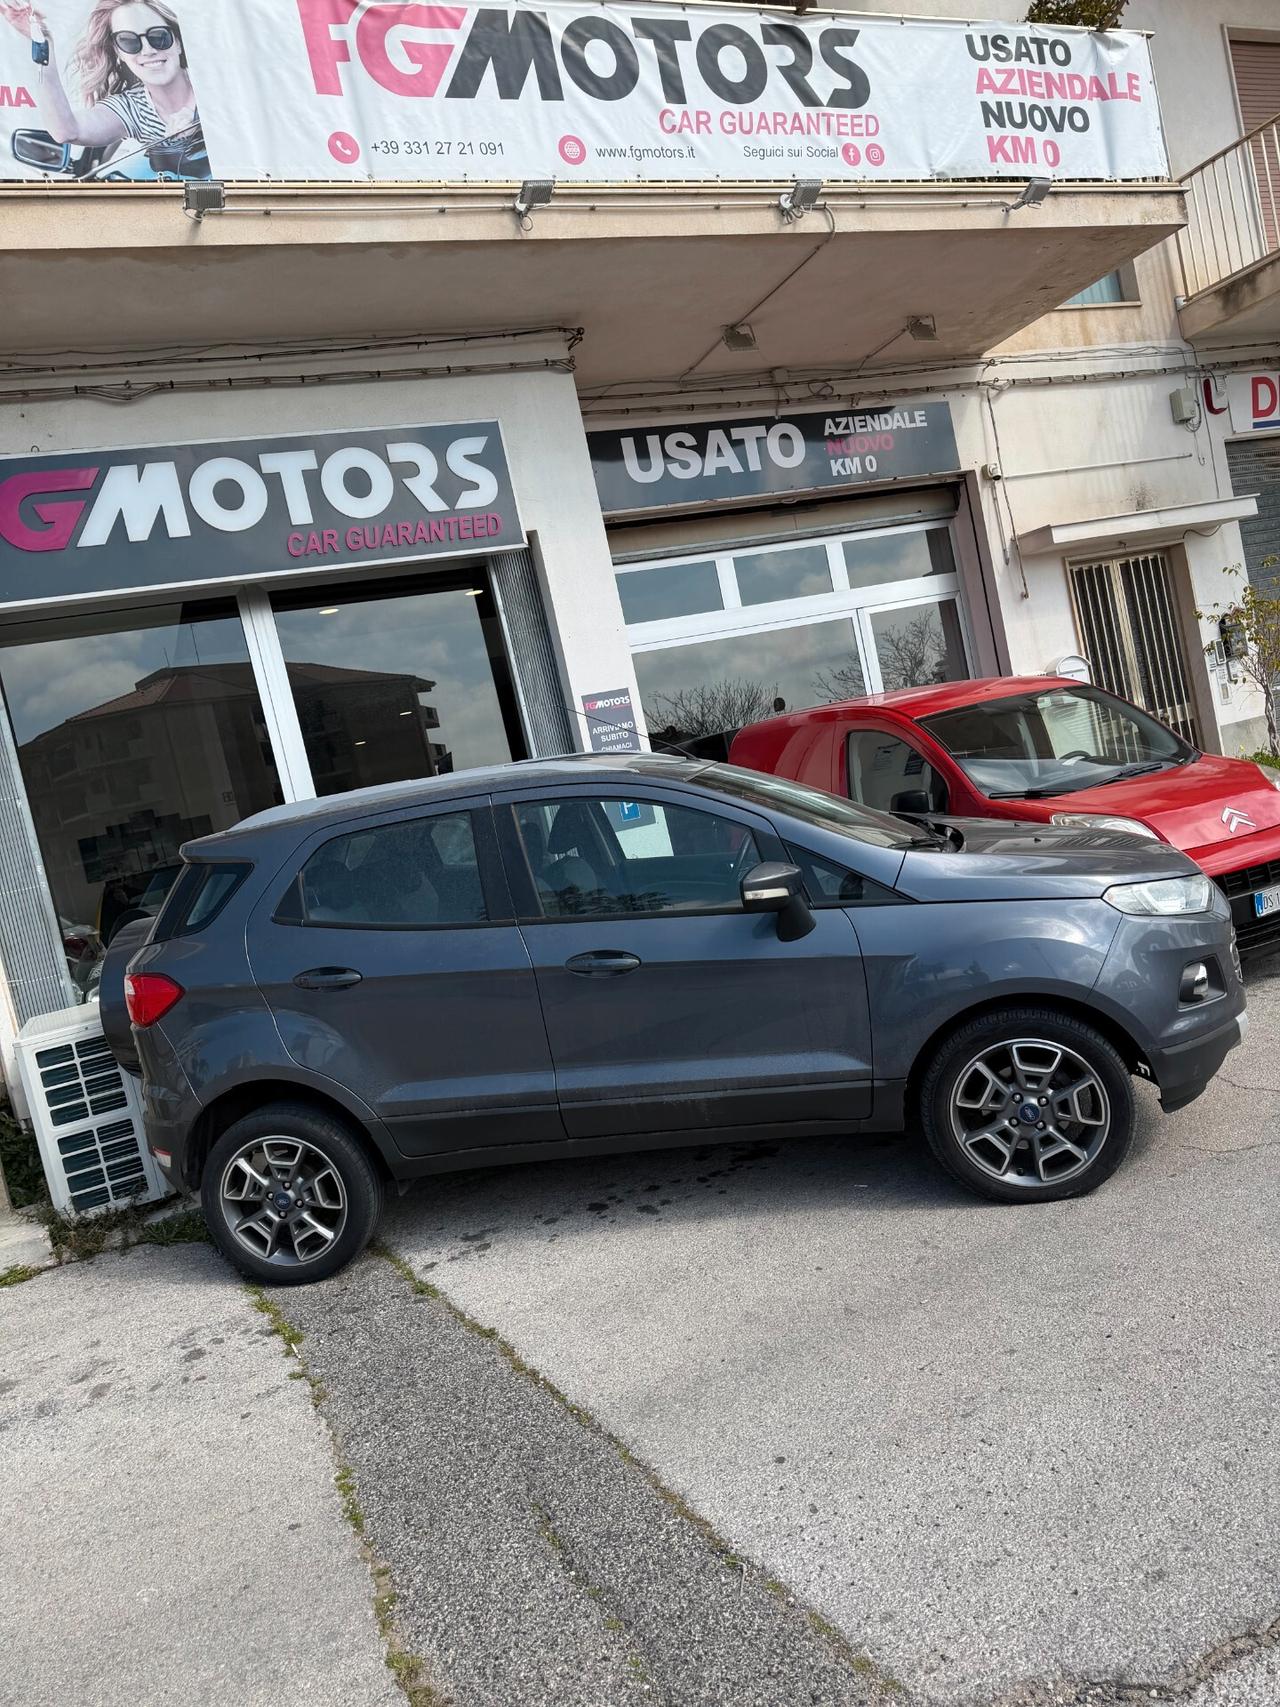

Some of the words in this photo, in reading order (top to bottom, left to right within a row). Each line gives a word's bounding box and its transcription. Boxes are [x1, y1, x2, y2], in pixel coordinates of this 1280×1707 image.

[298, 0, 871, 107] FGMOTORS
[965, 34, 1072, 67] USATO
[976, 67, 1142, 102] AZIENDALE
[659, 108, 713, 135] CAR
[719, 111, 880, 137] GUARANTEED
[980, 101, 1089, 133] NUOVO
[371, 140, 399, 155] +39
[404, 140, 430, 155] 331
[435, 141, 451, 155] 27
[458, 142, 474, 155] 21
[479, 142, 505, 155] 091
[595, 145, 696, 160] www.fgmotors.it
[743, 145, 784, 160] Seguici
[787, 146, 803, 158] sui
[806, 146, 839, 158] Social
[987, 135, 1037, 164] KM
[1043, 140, 1060, 167] 0
[824, 410, 928, 436] AZIENDALE
[620, 422, 806, 484] USATO
[826, 433, 895, 456] NUOVO
[830, 457, 862, 477] KM
[865, 455, 878, 473] 0
[0, 436, 499, 552] GMOTORS
[287, 529, 341, 558] CAR
[345, 512, 503, 552] GUARANTEED
[600, 731, 629, 743] SUBITO
